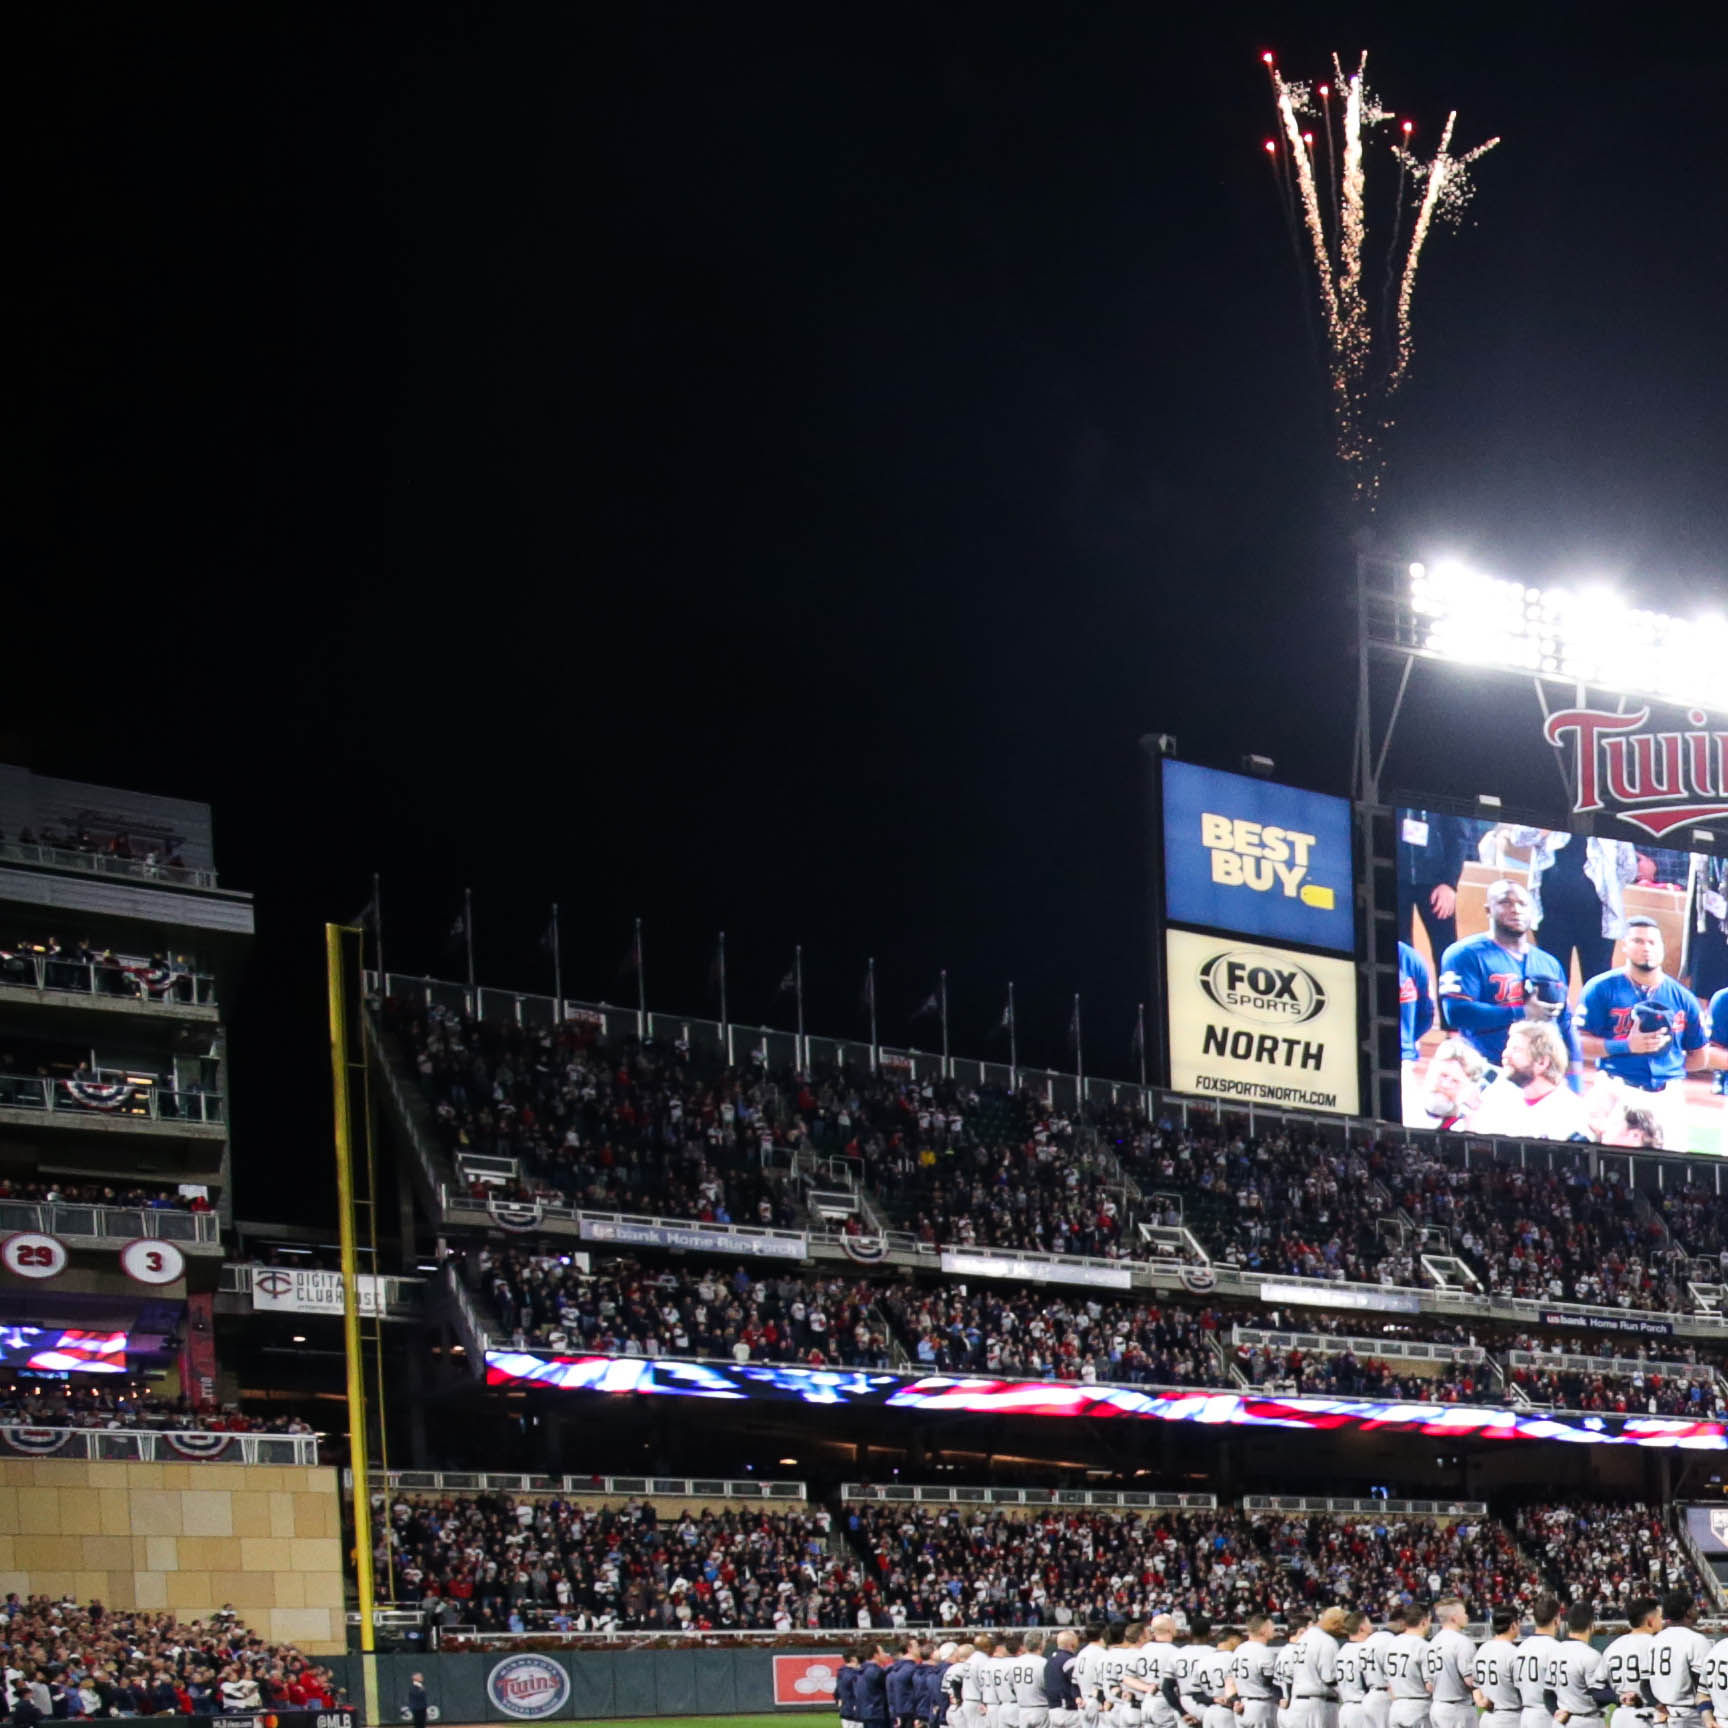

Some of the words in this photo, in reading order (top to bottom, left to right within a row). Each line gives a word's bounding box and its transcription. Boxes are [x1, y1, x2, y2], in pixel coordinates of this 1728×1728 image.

[1201, 812, 1317, 867] BEST
[1211, 850, 1307, 898] BUY
[1226, 961, 1299, 1002] FOX
[1226, 992, 1301, 1015] SPORTS
[1202, 1023, 1325, 1072] NORTH
[1196, 1075, 1337, 1108] FOXSPORTSNORTH.COM
[17, 1244, 53, 1268] 29
[146, 1251, 163, 1272] 3
[297, 1272, 345, 1289] DIGITA
[1590, 1317, 1618, 1329] Home
[1620, 1320, 1639, 1331] Run
[1640, 1322, 1667, 1334] Porch
[1136, 1657, 1160, 1680] 34
[1231, 1657, 1249, 1680] 45
[1387, 1652, 1410, 1679] 57
[1427, 1648, 1444, 1675] 65
[1475, 1659, 1499, 1686] 66
[1515, 1655, 1539, 1682] 70
[1609, 1655, 1640, 1684] 29
[1650, 1646, 1673, 1677] 18
[1706, 1658, 1728, 1692] 25
[496, 1673, 560, 1699] Twins
[1012, 1666, 1033, 1685] 88
[1199, 1667, 1226, 1691] 43
[400, 1704, 440, 1721] 39
